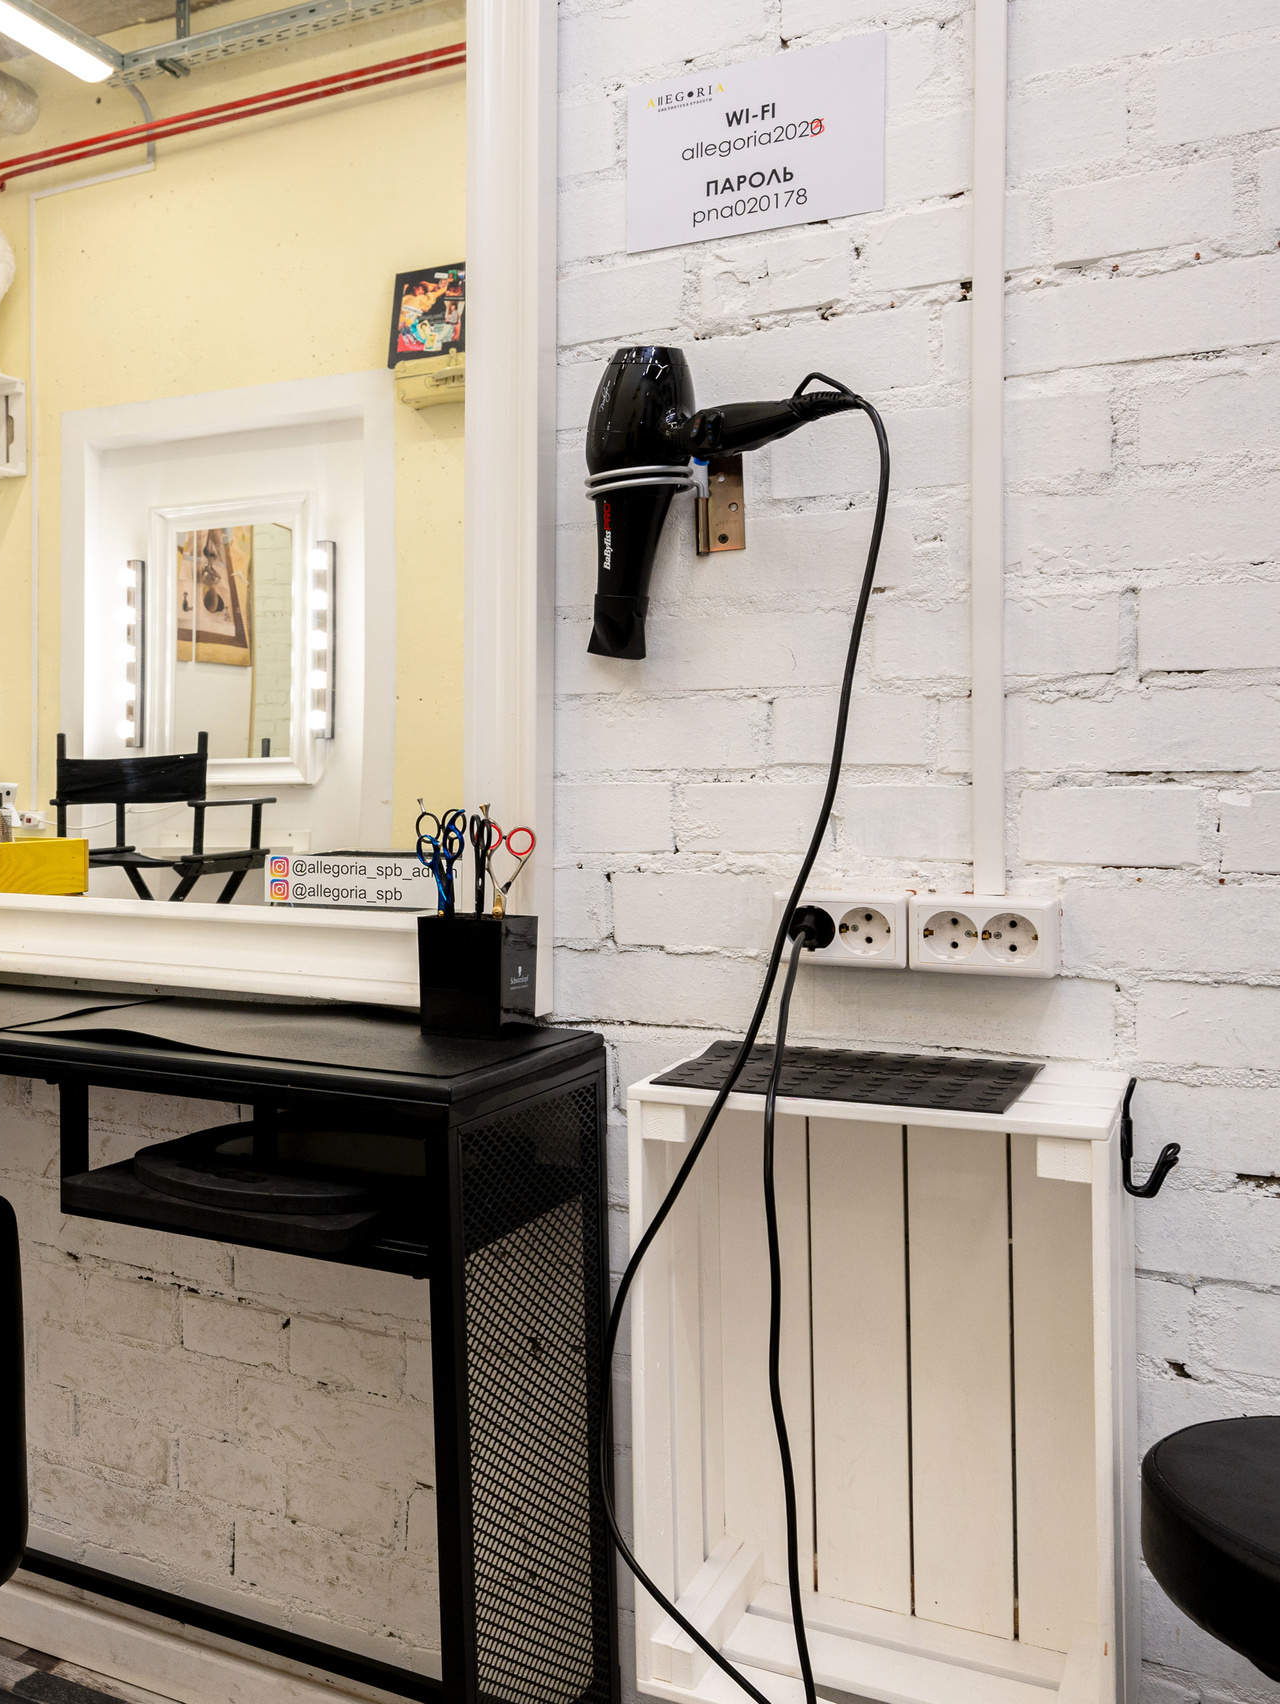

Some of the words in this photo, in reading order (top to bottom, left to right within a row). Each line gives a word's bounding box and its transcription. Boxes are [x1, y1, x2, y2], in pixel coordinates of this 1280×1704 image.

[725, 102, 776, 127] WI-FI
[705, 166, 794, 197] ПАРОЛЬ
[692, 188, 808, 227] pna020178
[292, 881, 403, 904] @allegoria_spb
